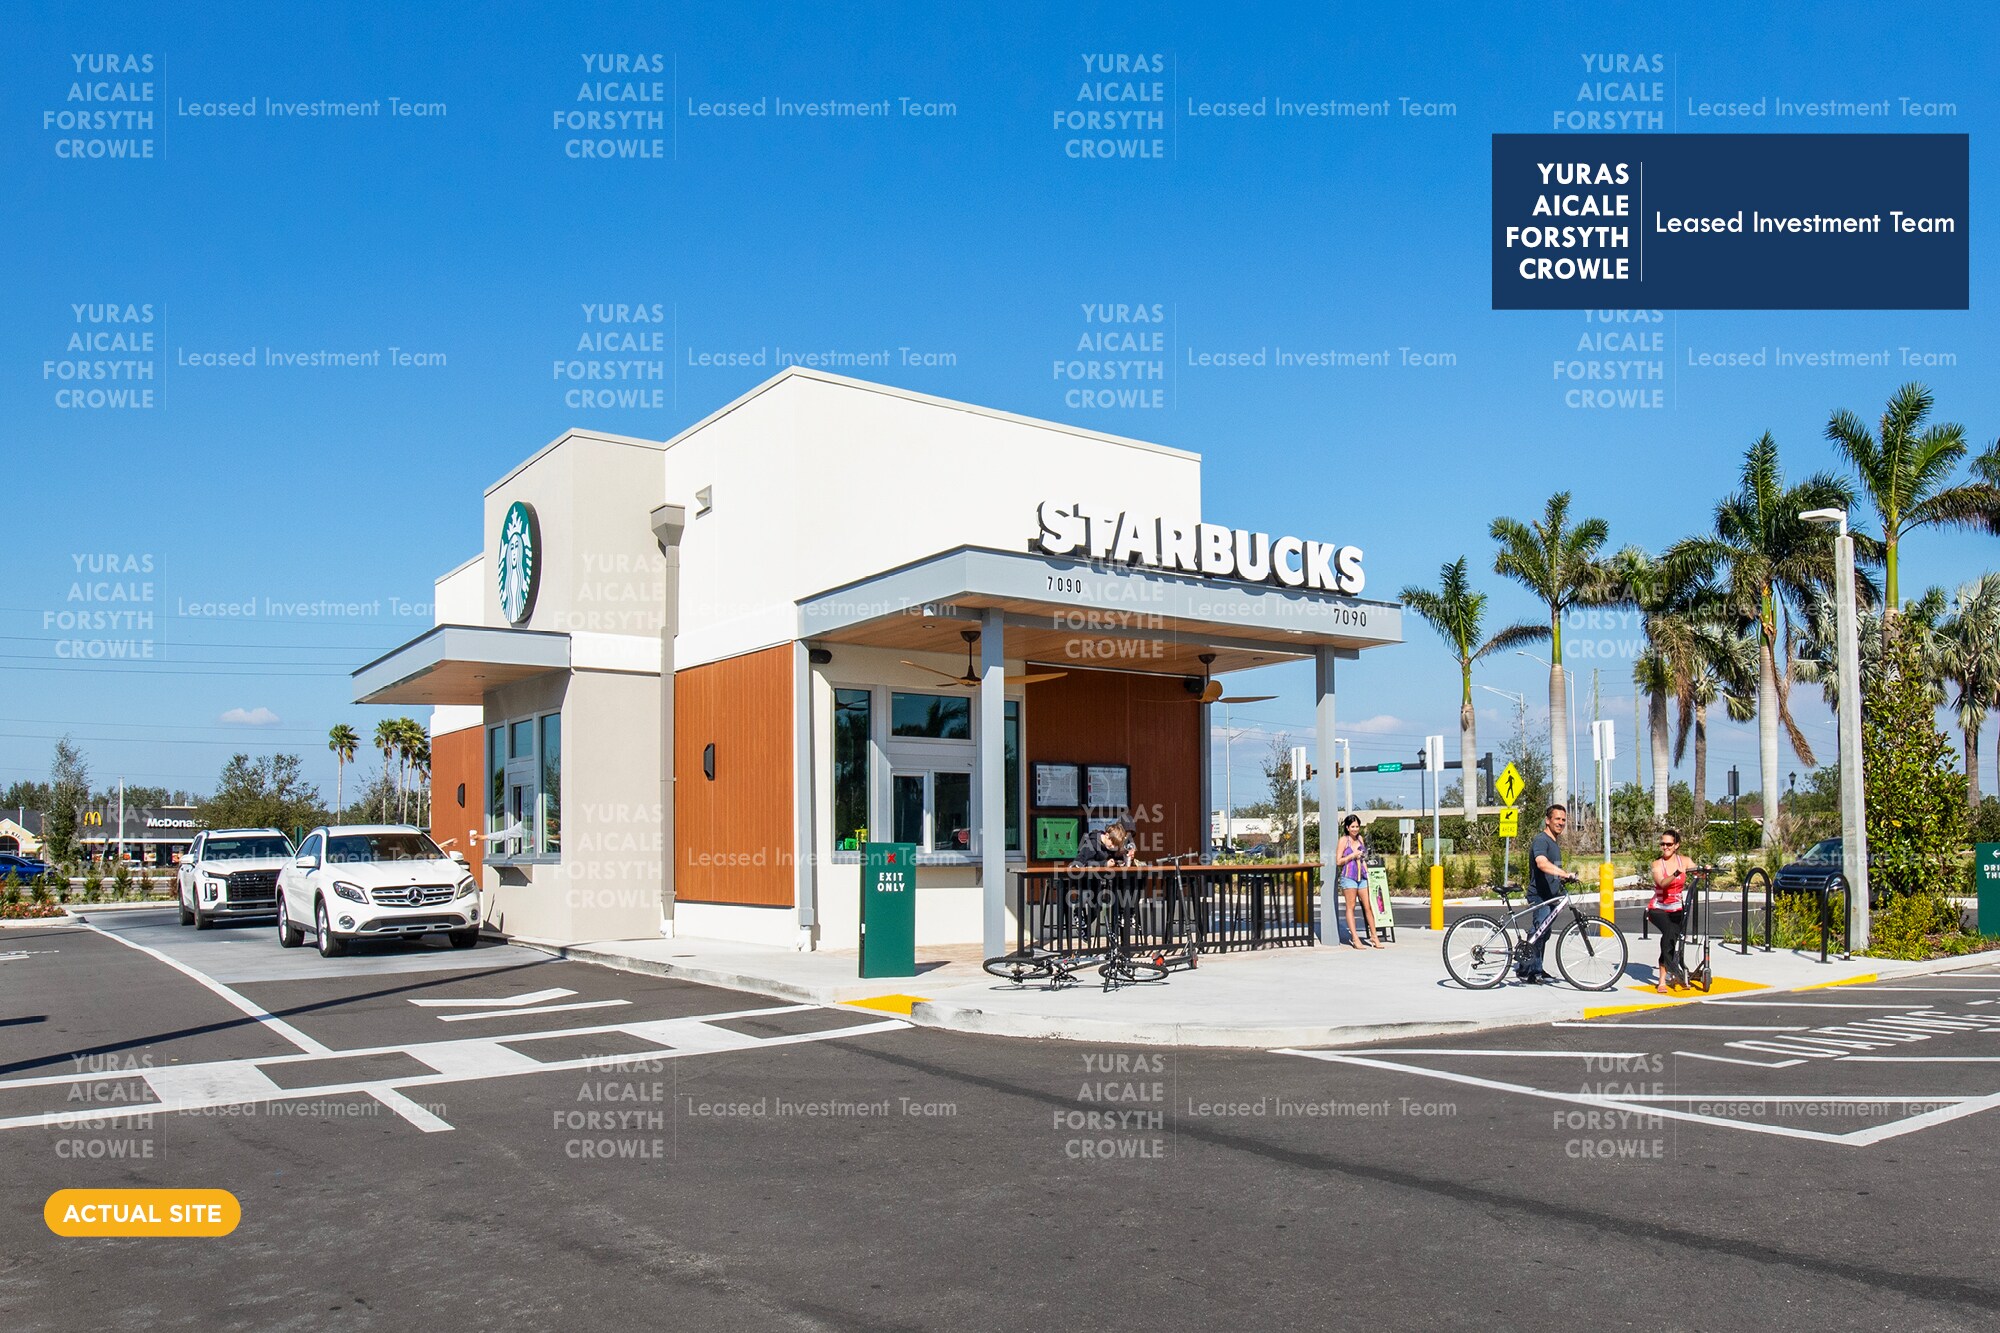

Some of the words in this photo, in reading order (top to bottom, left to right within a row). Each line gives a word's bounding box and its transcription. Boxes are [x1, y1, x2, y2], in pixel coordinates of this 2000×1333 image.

[1037, 499, 1366, 595] STARBUCKS
[1047, 576, 1082, 594] 7090
[1333, 608, 1367, 627] 7090
[879, 872, 904, 882] EXIT
[877, 882, 906, 892] ONLY
